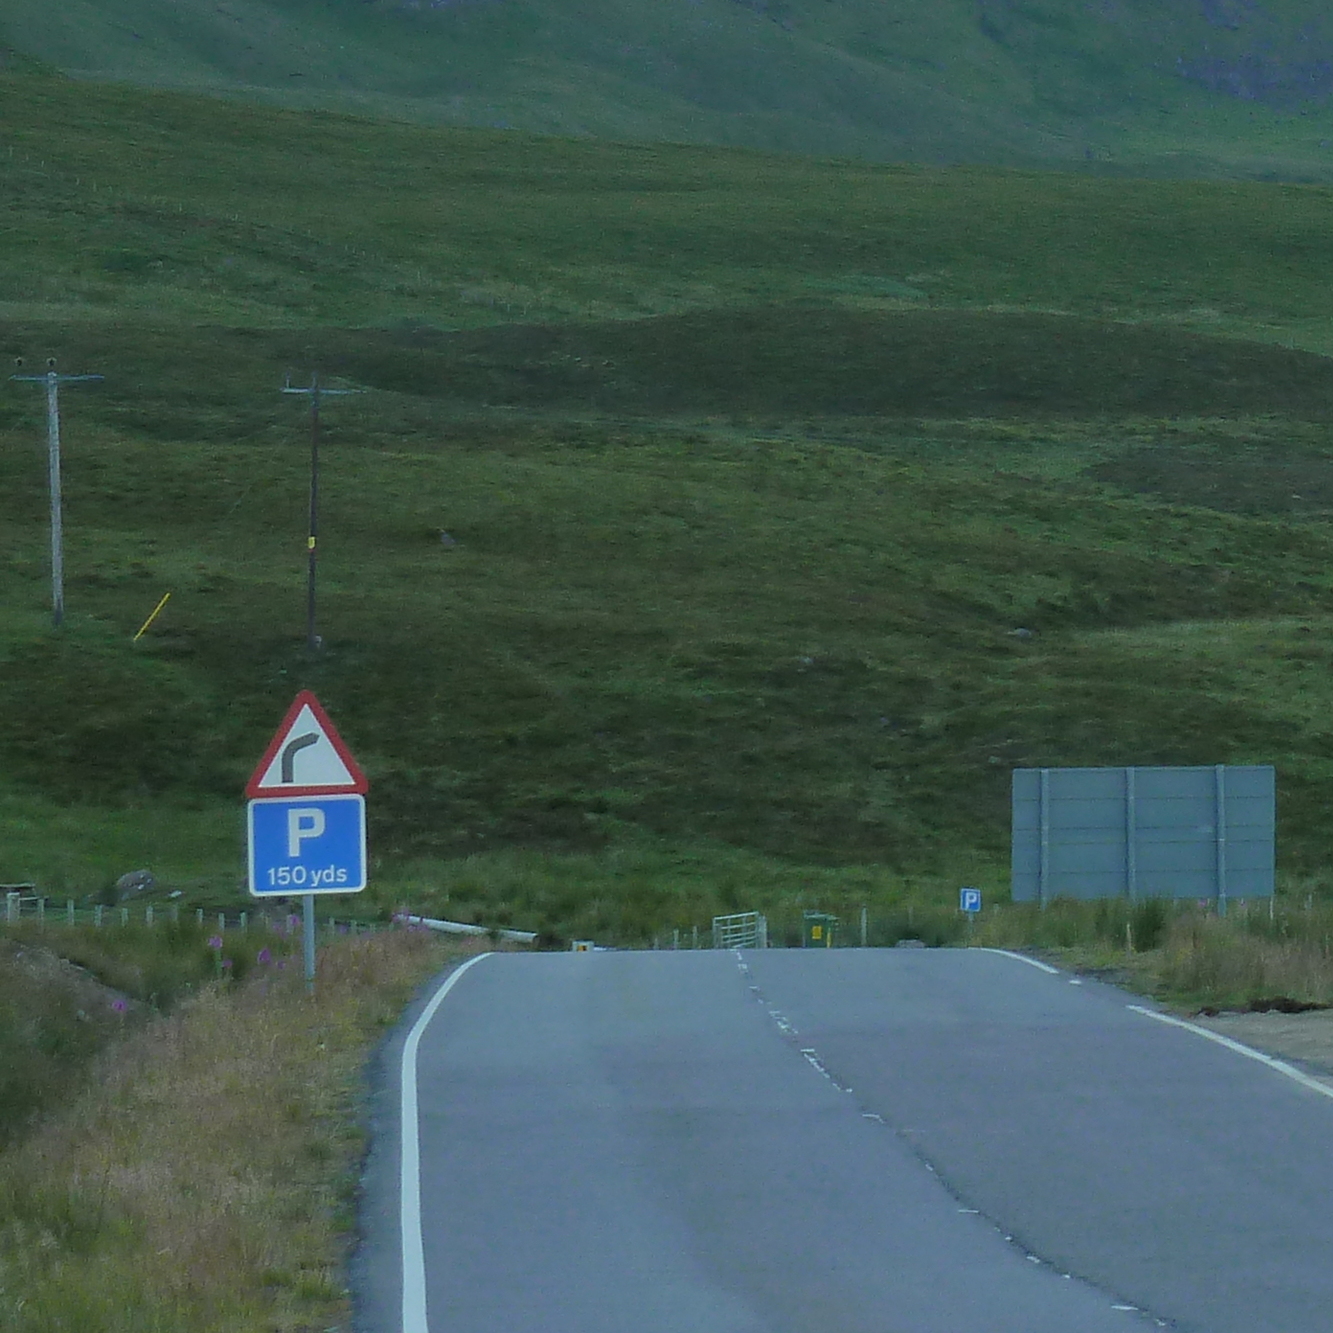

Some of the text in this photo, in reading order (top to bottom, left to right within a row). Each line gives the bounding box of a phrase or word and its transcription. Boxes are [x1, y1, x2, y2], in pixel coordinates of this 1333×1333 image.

[288, 808, 325, 857] P
[268, 864, 347, 887] 150 yds
[966, 892, 977, 910] P
